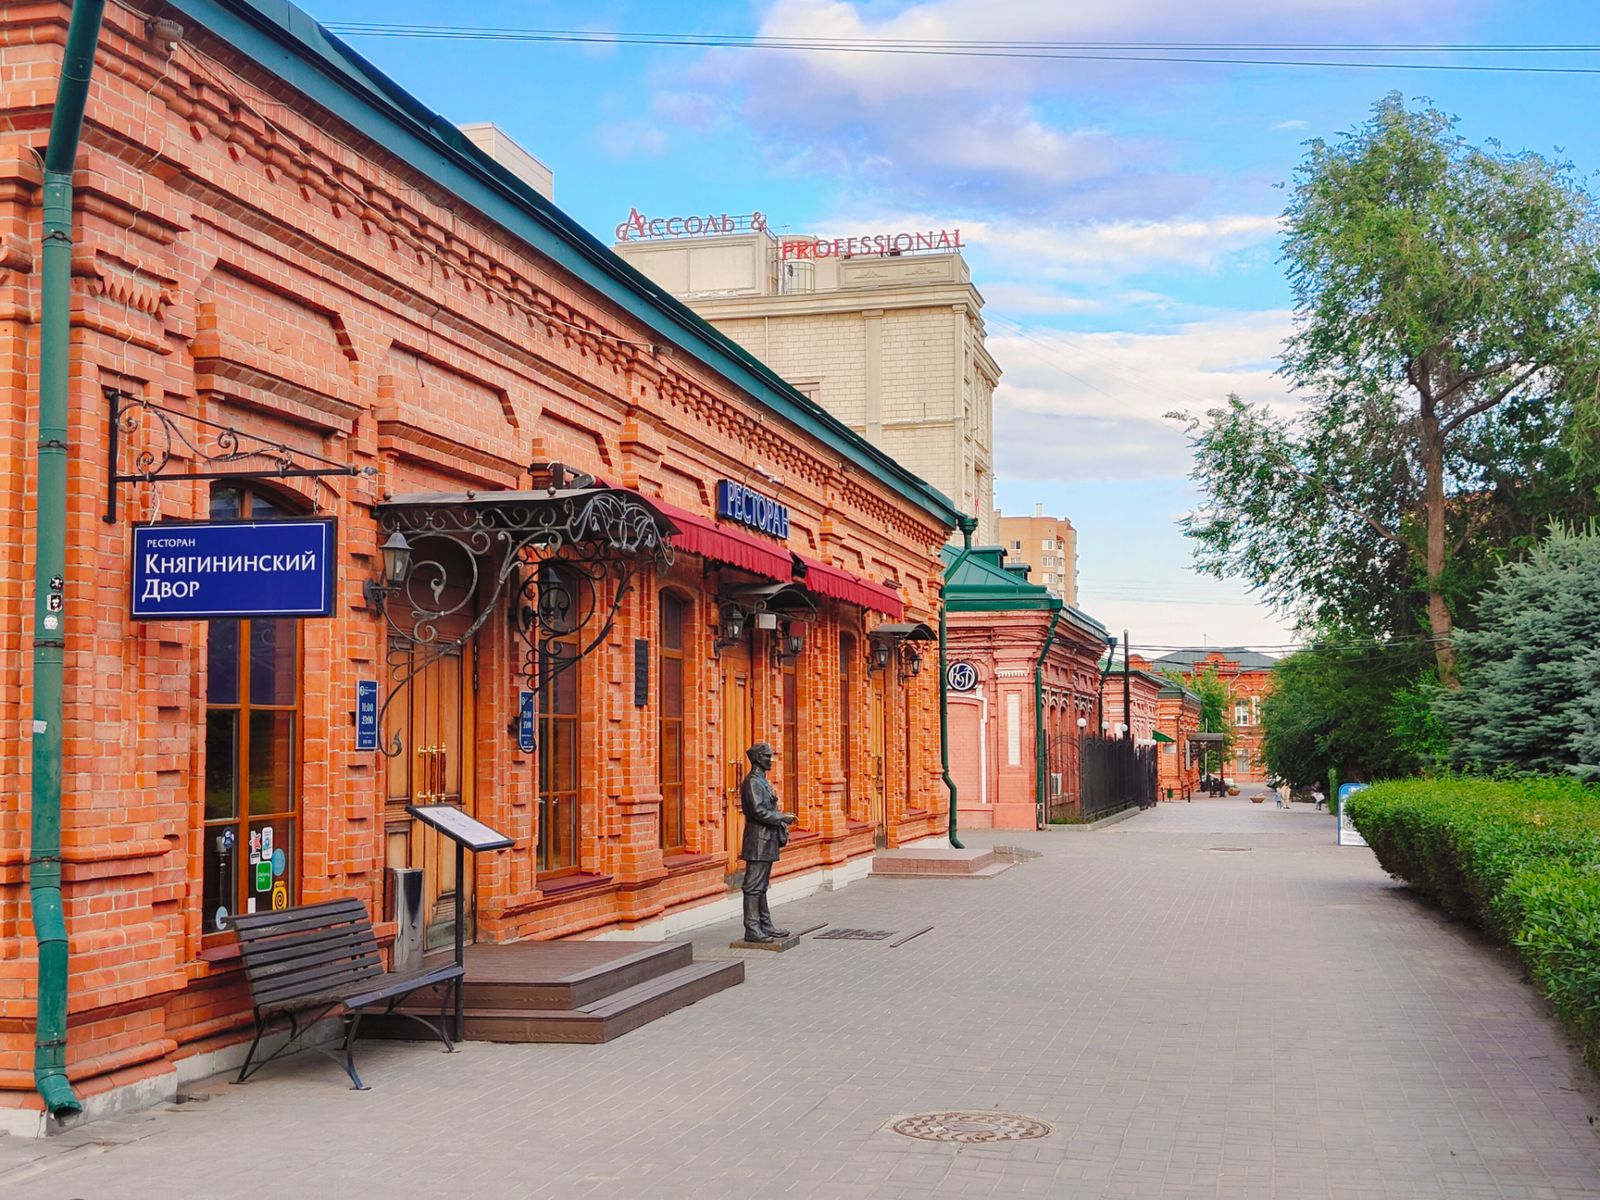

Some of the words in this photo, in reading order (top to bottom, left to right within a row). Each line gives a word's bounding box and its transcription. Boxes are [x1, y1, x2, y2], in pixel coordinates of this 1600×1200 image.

[750, 211, 766, 232] &
[782, 228, 966, 261] PROFESSIONAL
[726, 479, 790, 539] РЕСТОРАН
[146, 538, 196, 548] РЕСТОРАН
